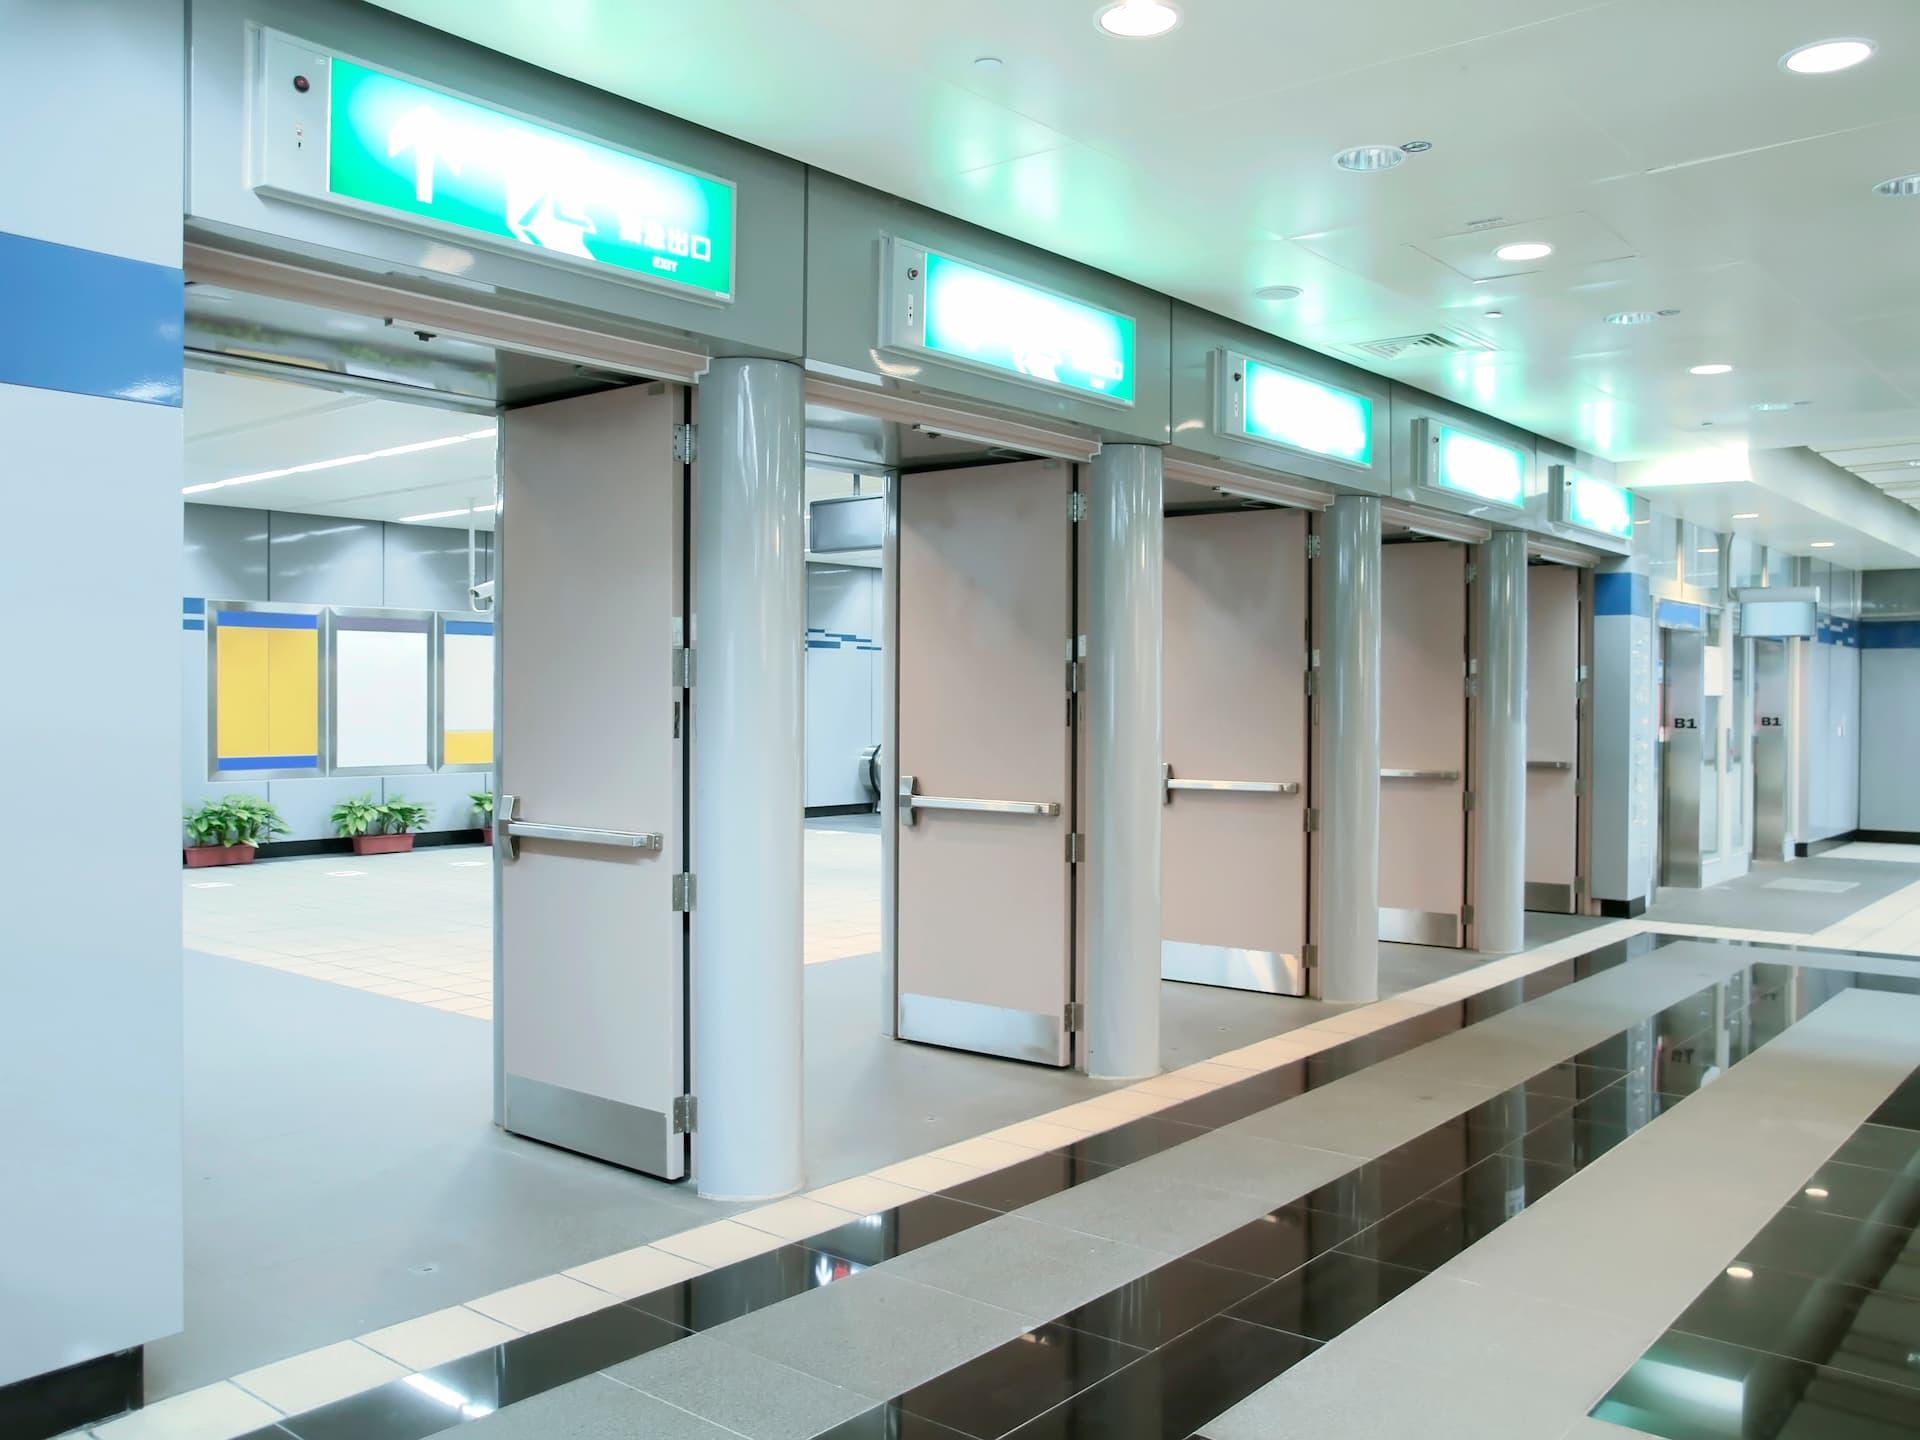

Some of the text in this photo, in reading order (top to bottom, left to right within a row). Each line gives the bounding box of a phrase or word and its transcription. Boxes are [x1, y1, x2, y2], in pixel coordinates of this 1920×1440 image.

[652, 256, 678, 272] EXIT
[1674, 718, 1697, 729] B1
[1761, 716, 1781, 727] B1
